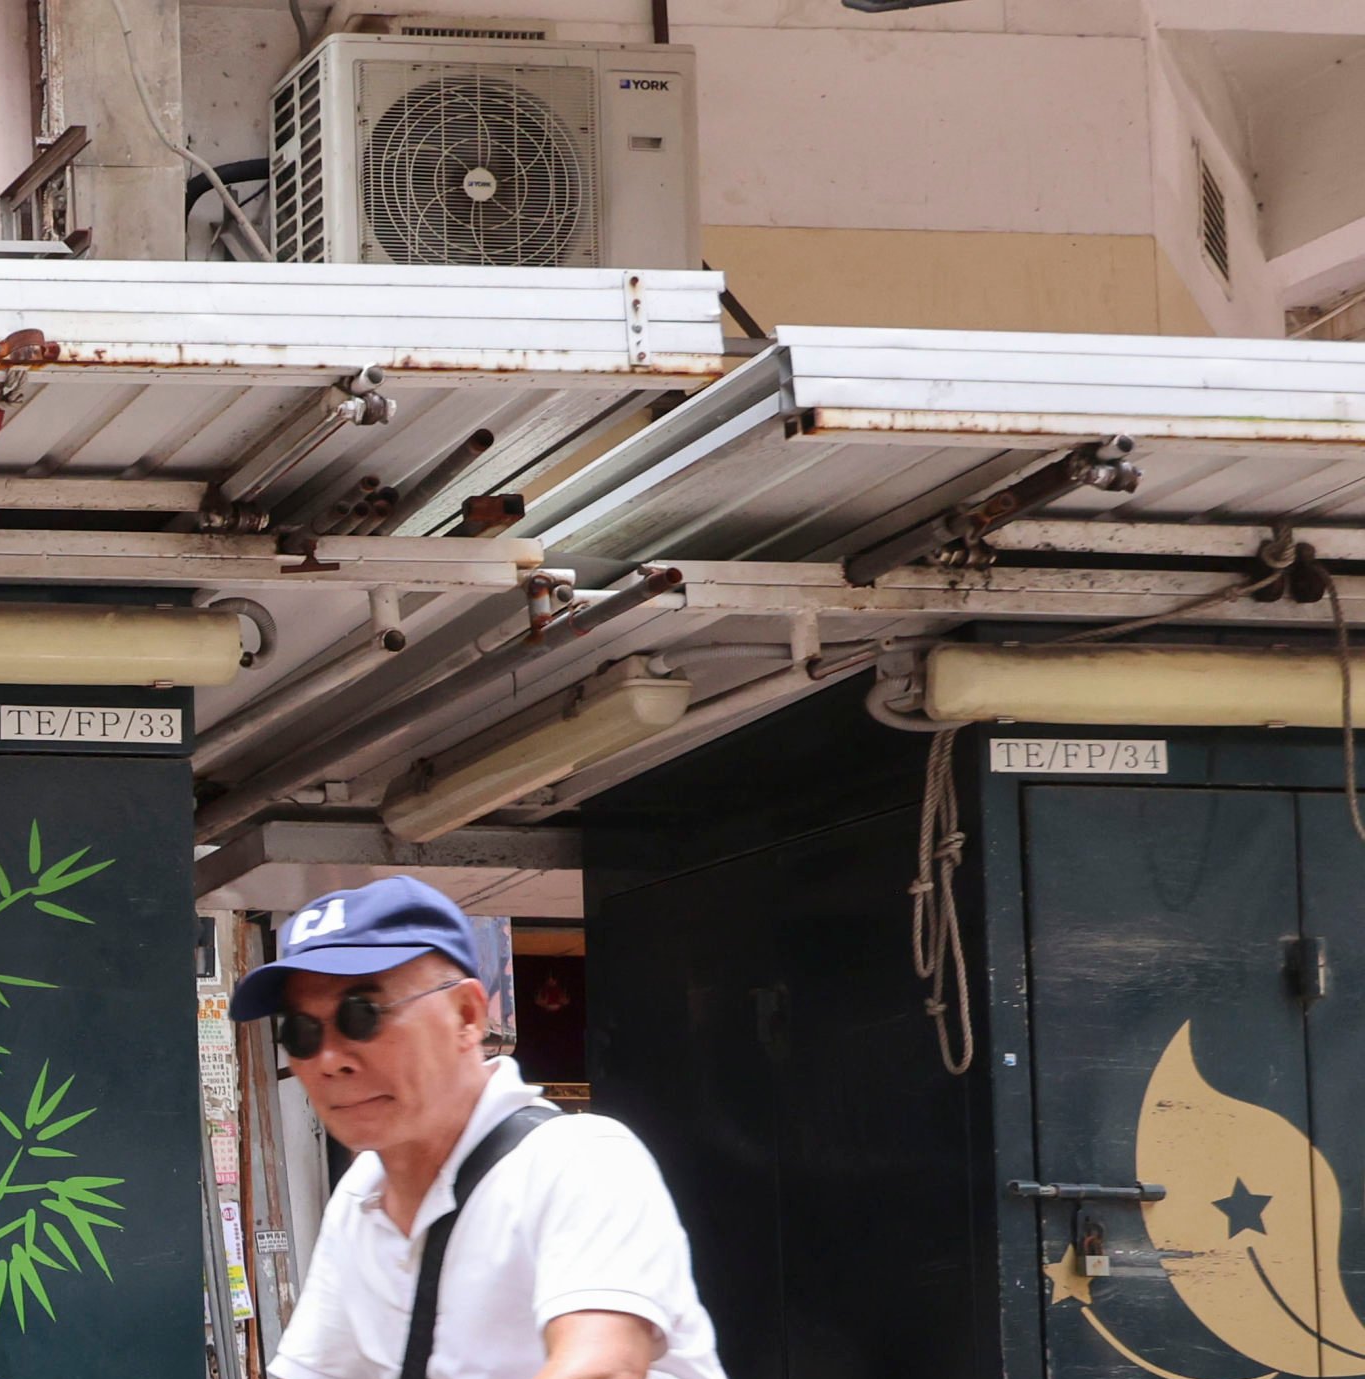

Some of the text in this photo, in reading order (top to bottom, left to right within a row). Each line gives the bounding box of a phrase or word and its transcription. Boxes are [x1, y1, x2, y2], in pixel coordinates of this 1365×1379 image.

[632, 79, 669, 91] YORK
[7, 708, 175, 739] TE/FP/33
[996, 741, 1161, 770] TE/FP/34
